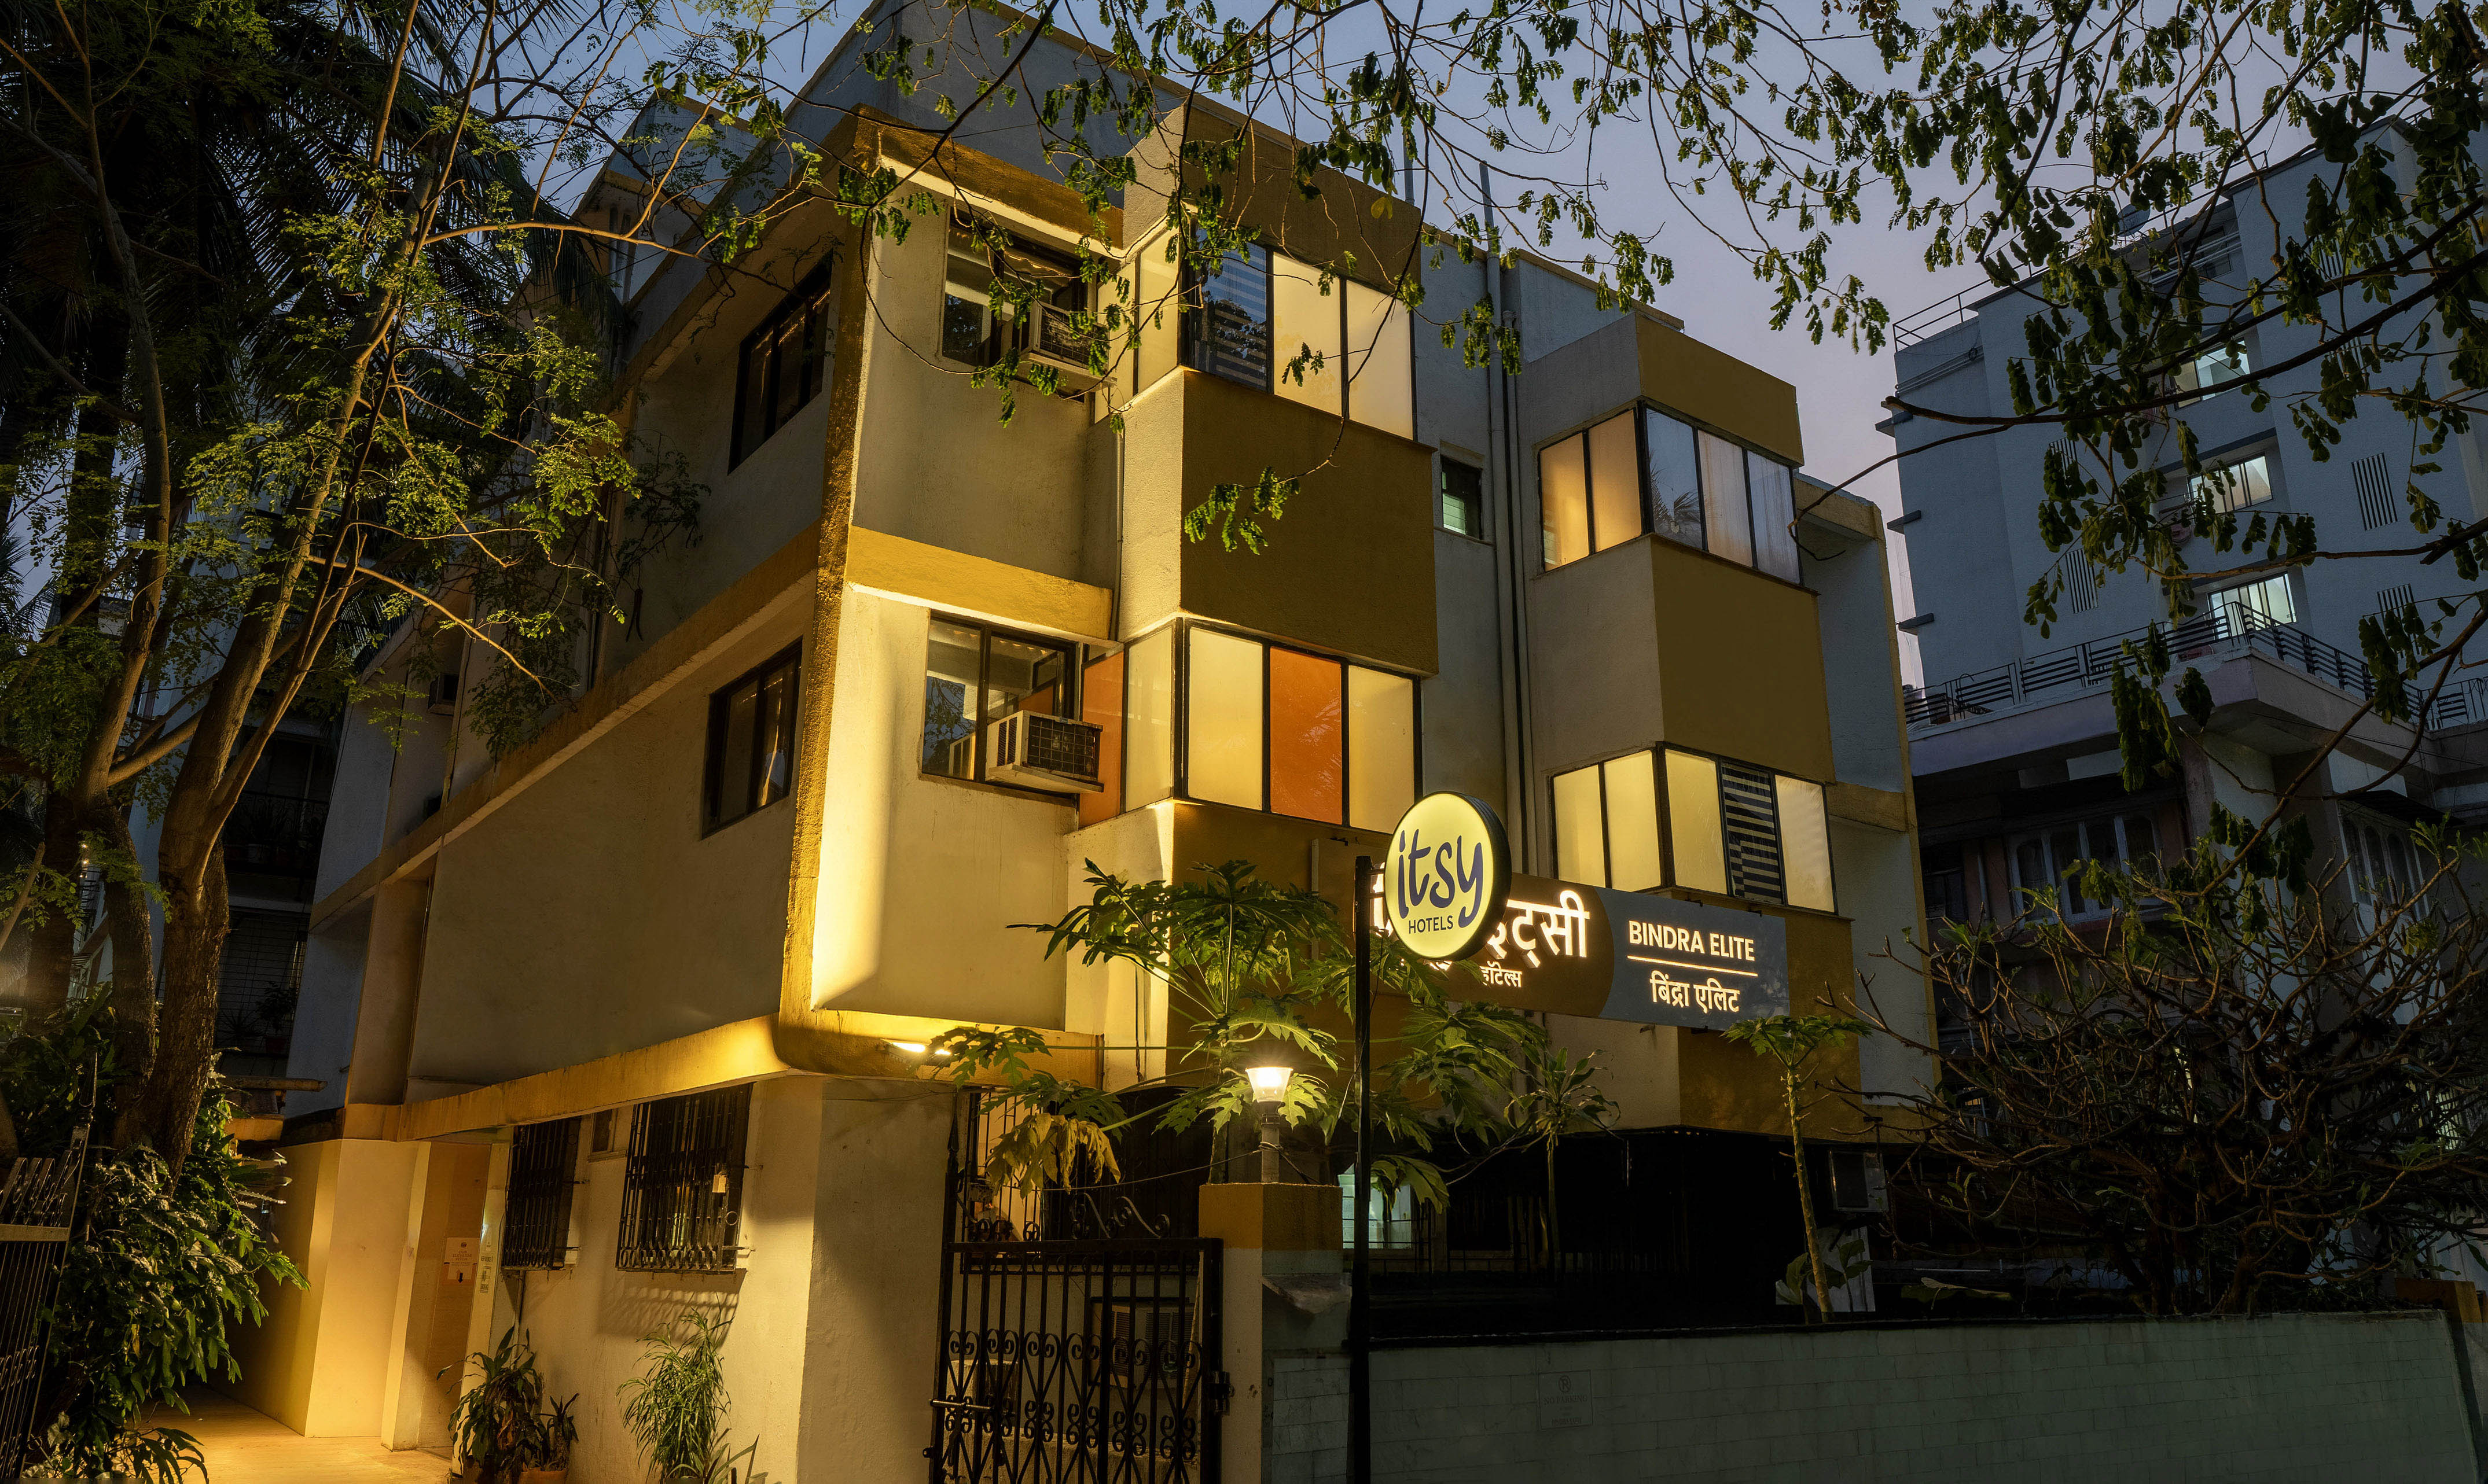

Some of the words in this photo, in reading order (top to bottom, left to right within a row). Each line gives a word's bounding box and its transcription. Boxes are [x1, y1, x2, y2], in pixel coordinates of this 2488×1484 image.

[1398, 828, 1484, 928] itsy
[1409, 915, 1454, 934] HOTELS
[1629, 920, 1706, 954] BINDRA
[1710, 933, 1755, 962] ELITE
[1649, 970, 1690, 1008] बिंद्रा
[1693, 977, 1741, 1014] एलिट
[1543, 1397, 1555, 1405] NO
[1557, 1394, 1588, 1404] PARKING
